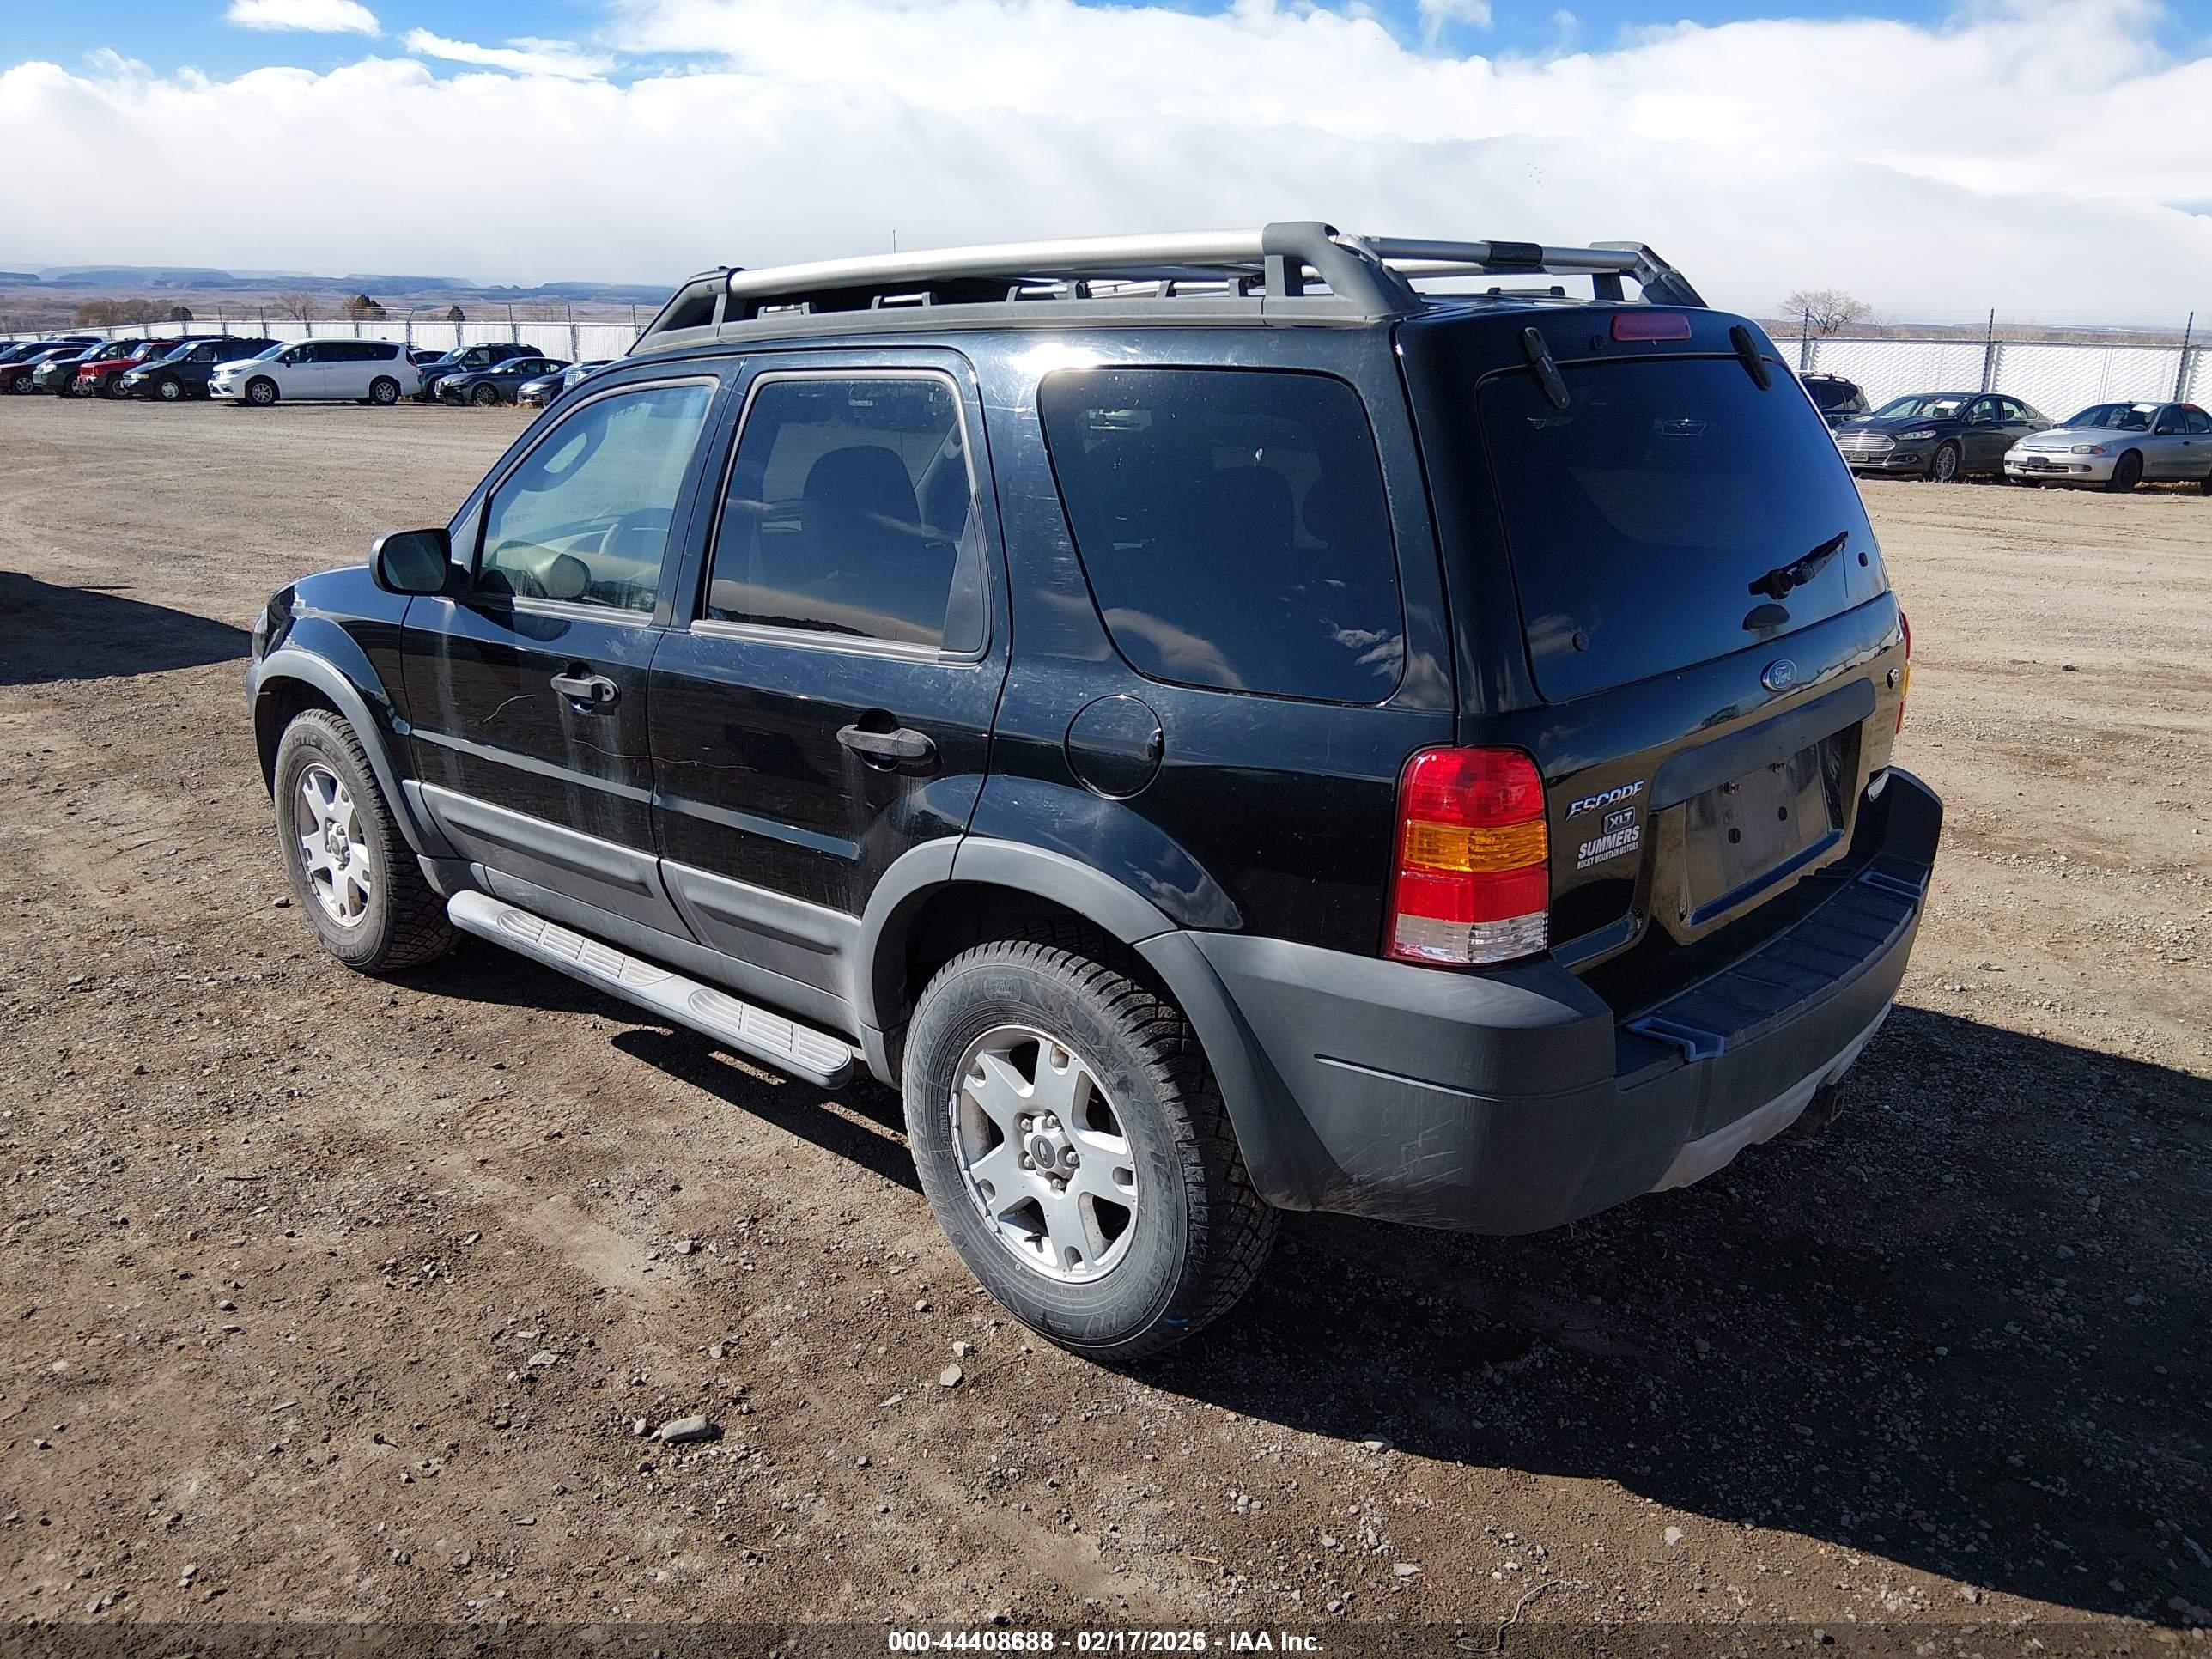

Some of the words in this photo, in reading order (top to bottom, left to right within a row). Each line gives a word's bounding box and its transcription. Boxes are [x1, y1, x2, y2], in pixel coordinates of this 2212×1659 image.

[1565, 780, 1644, 821] ESCAPE
[1609, 811, 1632, 830] XLT
[1577, 856, 1595, 870] ROCKY
[1595, 848, 1620, 863] MOUNTAIN
[1620, 842, 1639, 854] MOTORS
[1578, 825, 1640, 860] SUMMERS
